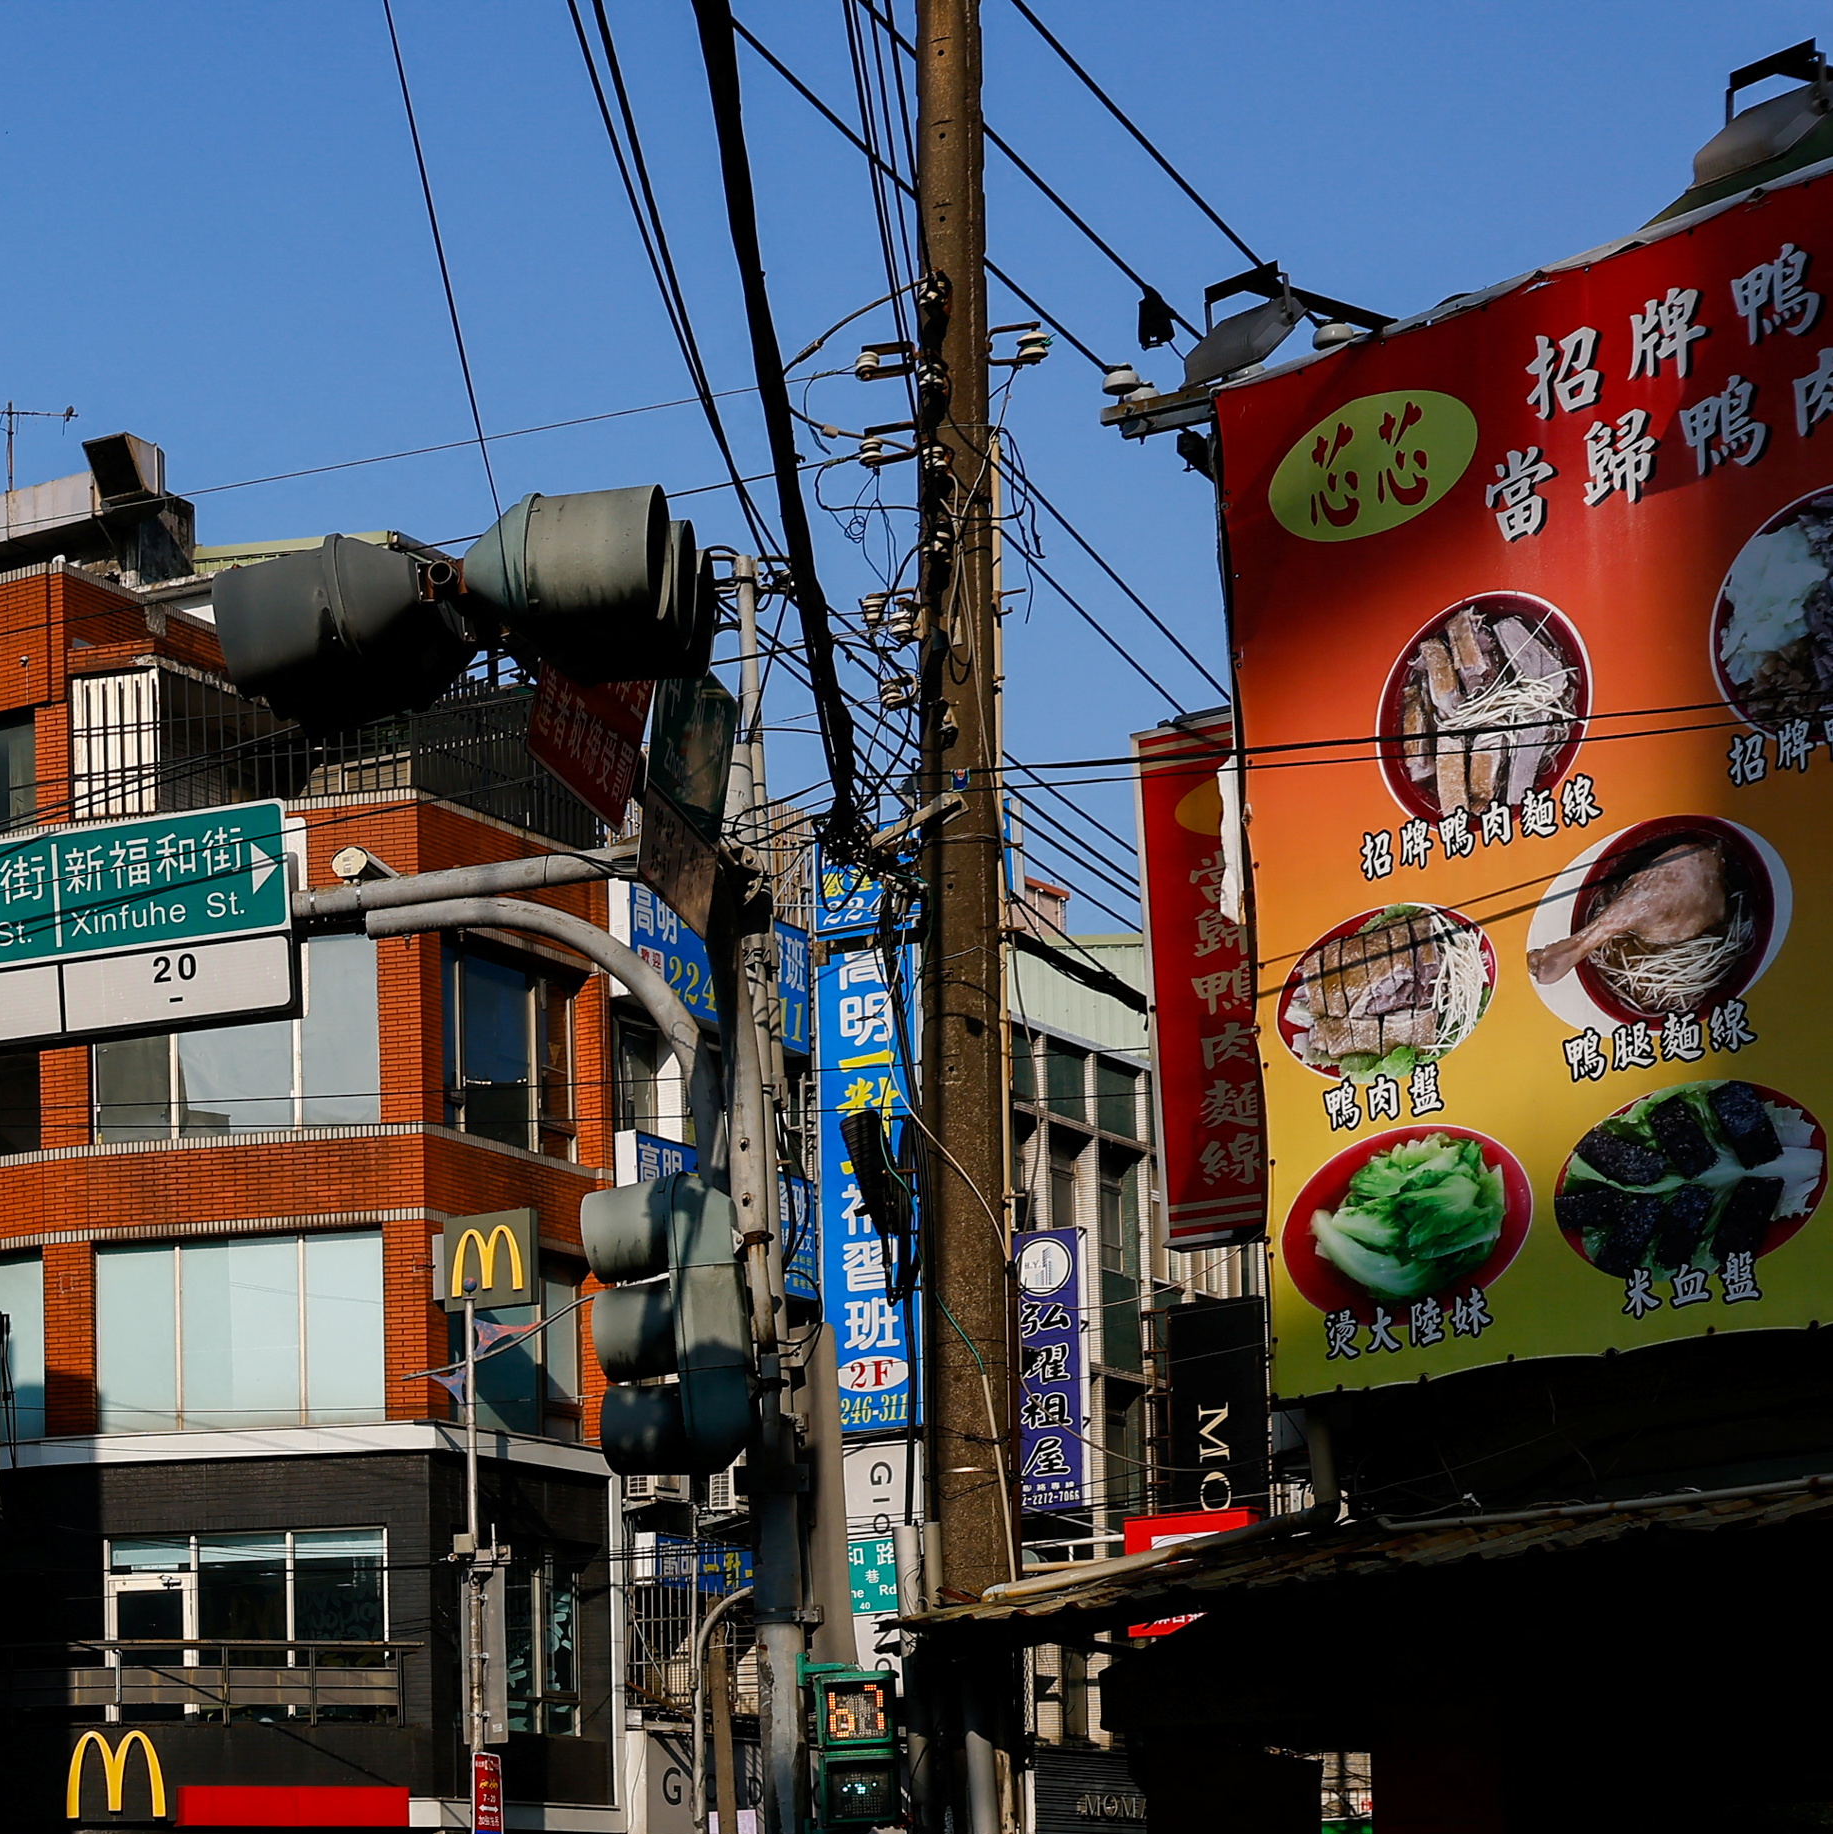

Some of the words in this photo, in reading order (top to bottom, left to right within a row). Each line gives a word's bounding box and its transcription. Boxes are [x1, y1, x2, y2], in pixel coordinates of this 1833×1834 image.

[1526, 243, 1820, 420] 招牌鴨
[1361, 773, 1604, 879] 招牌鴨肉麵線
[64, 826, 243, 895] 新福和街
[70, 901, 187, 937] Xinfuhe
[206, 890, 247, 918] St.
[151, 952, 198, 984] 20
[1563, 998, 1758, 1082] 鴨腿麵線
[1326, 1064, 1445, 1131] 鴨肉盤
[1623, 1251, 1762, 1317] 米血盤
[1326, 1288, 1493, 1360] 燙大陸妹
[850, 1359, 894, 1389] 2F
[859, 1602, 871, 1611] 40
